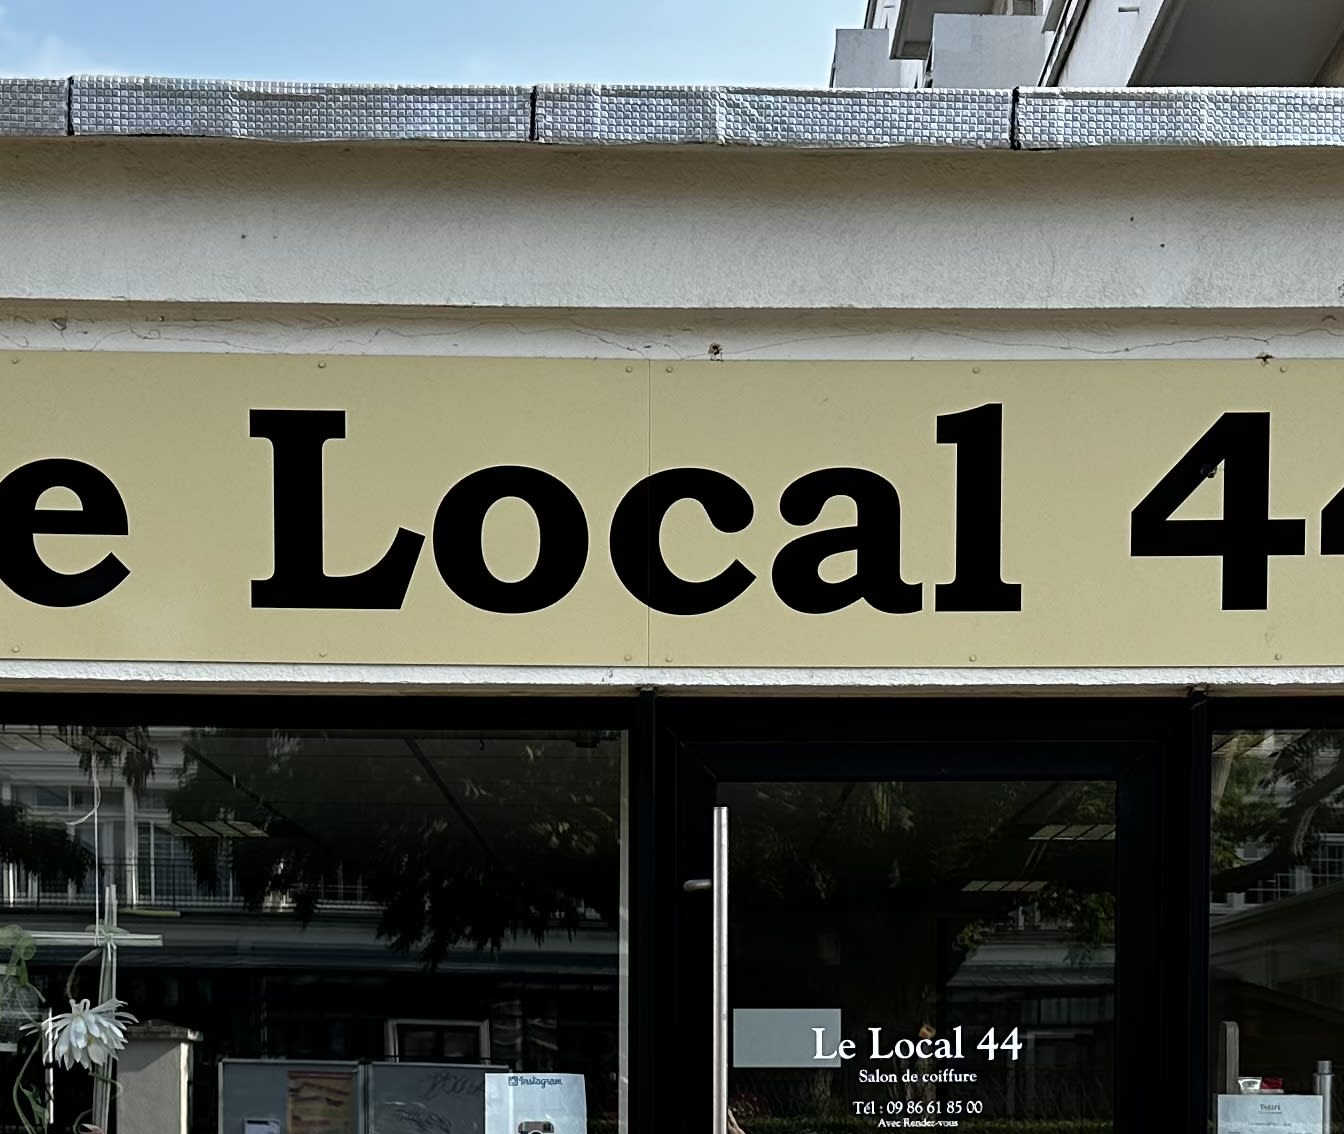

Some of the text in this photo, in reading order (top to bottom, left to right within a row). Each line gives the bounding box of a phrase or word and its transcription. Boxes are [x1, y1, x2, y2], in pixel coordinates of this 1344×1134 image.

[249, 403, 1022, 616] Local
[811, 1026, 1023, 1061] Le Local 44
[518, 1076, 563, 1089] Instagram
[858, 1069, 978, 1083] Salon de coiffure
[852, 1100, 876, 1115] Tél
[886, 1100, 904, 1115] 09
[906, 1100, 924, 1115] 86
[926, 1100, 942, 1115] 61
[946, 1100, 963, 1114] 85
[966, 1100, 983, 1114] 00
[877, 1117, 959, 1128] Avec Rendez-vous
